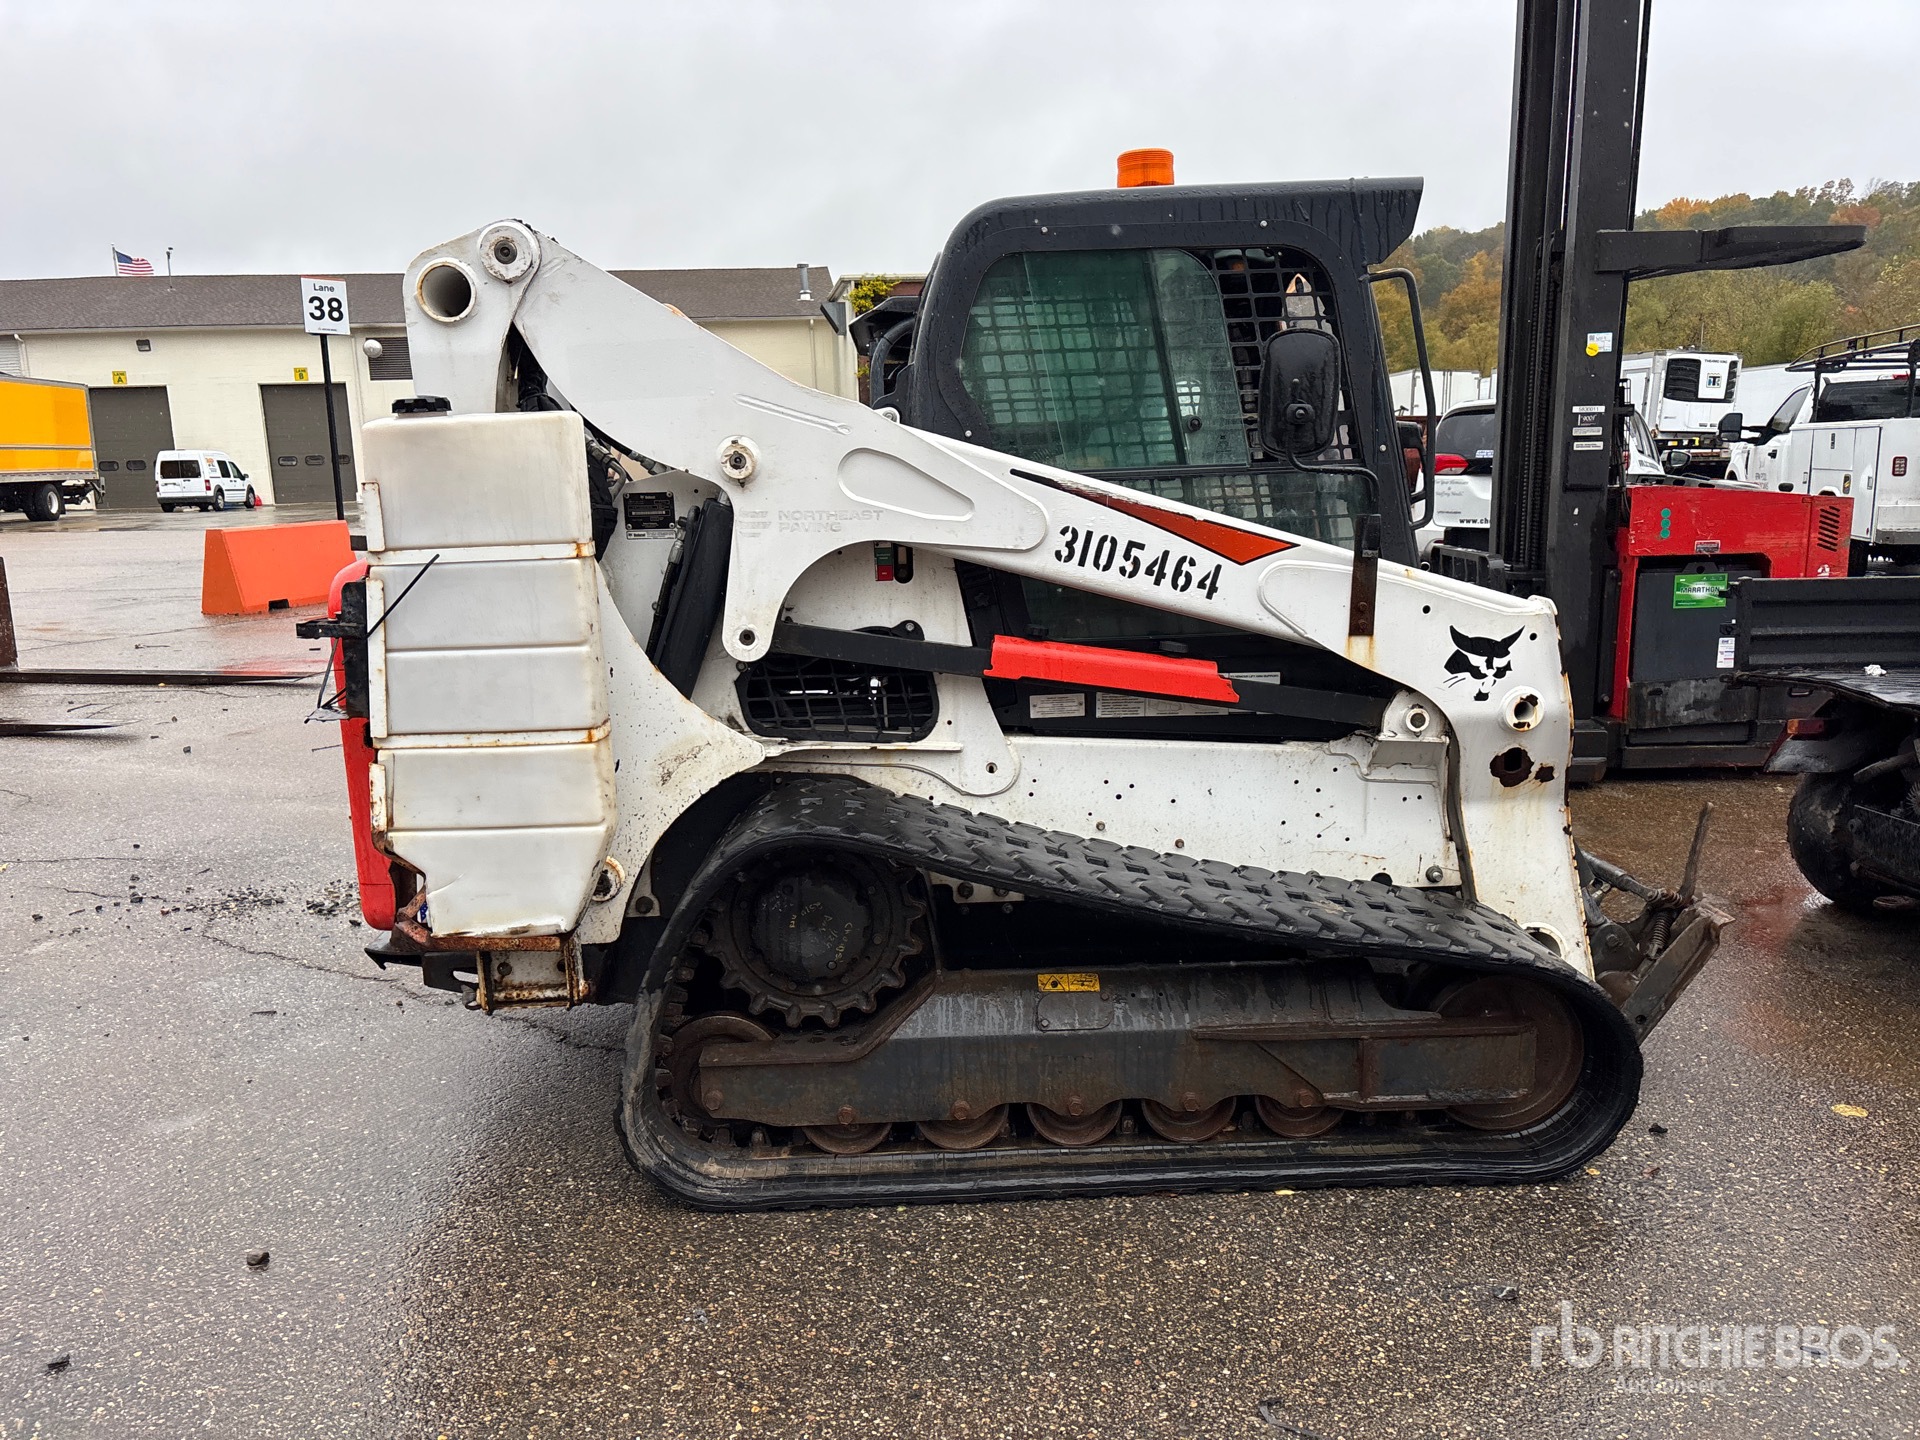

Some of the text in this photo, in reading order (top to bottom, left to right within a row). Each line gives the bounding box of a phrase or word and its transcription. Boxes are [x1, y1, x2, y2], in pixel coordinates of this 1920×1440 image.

[313, 283, 335, 292] Lane
[308, 296, 344, 322] 38
[778, 509, 884, 521] NORTHEAST
[1459, 517, 1490, 525] www.ch
[779, 522, 842, 533] PAVING
[1054, 525, 1223, 601] 3105464
[1680, 586, 1720, 594] MARATHON
